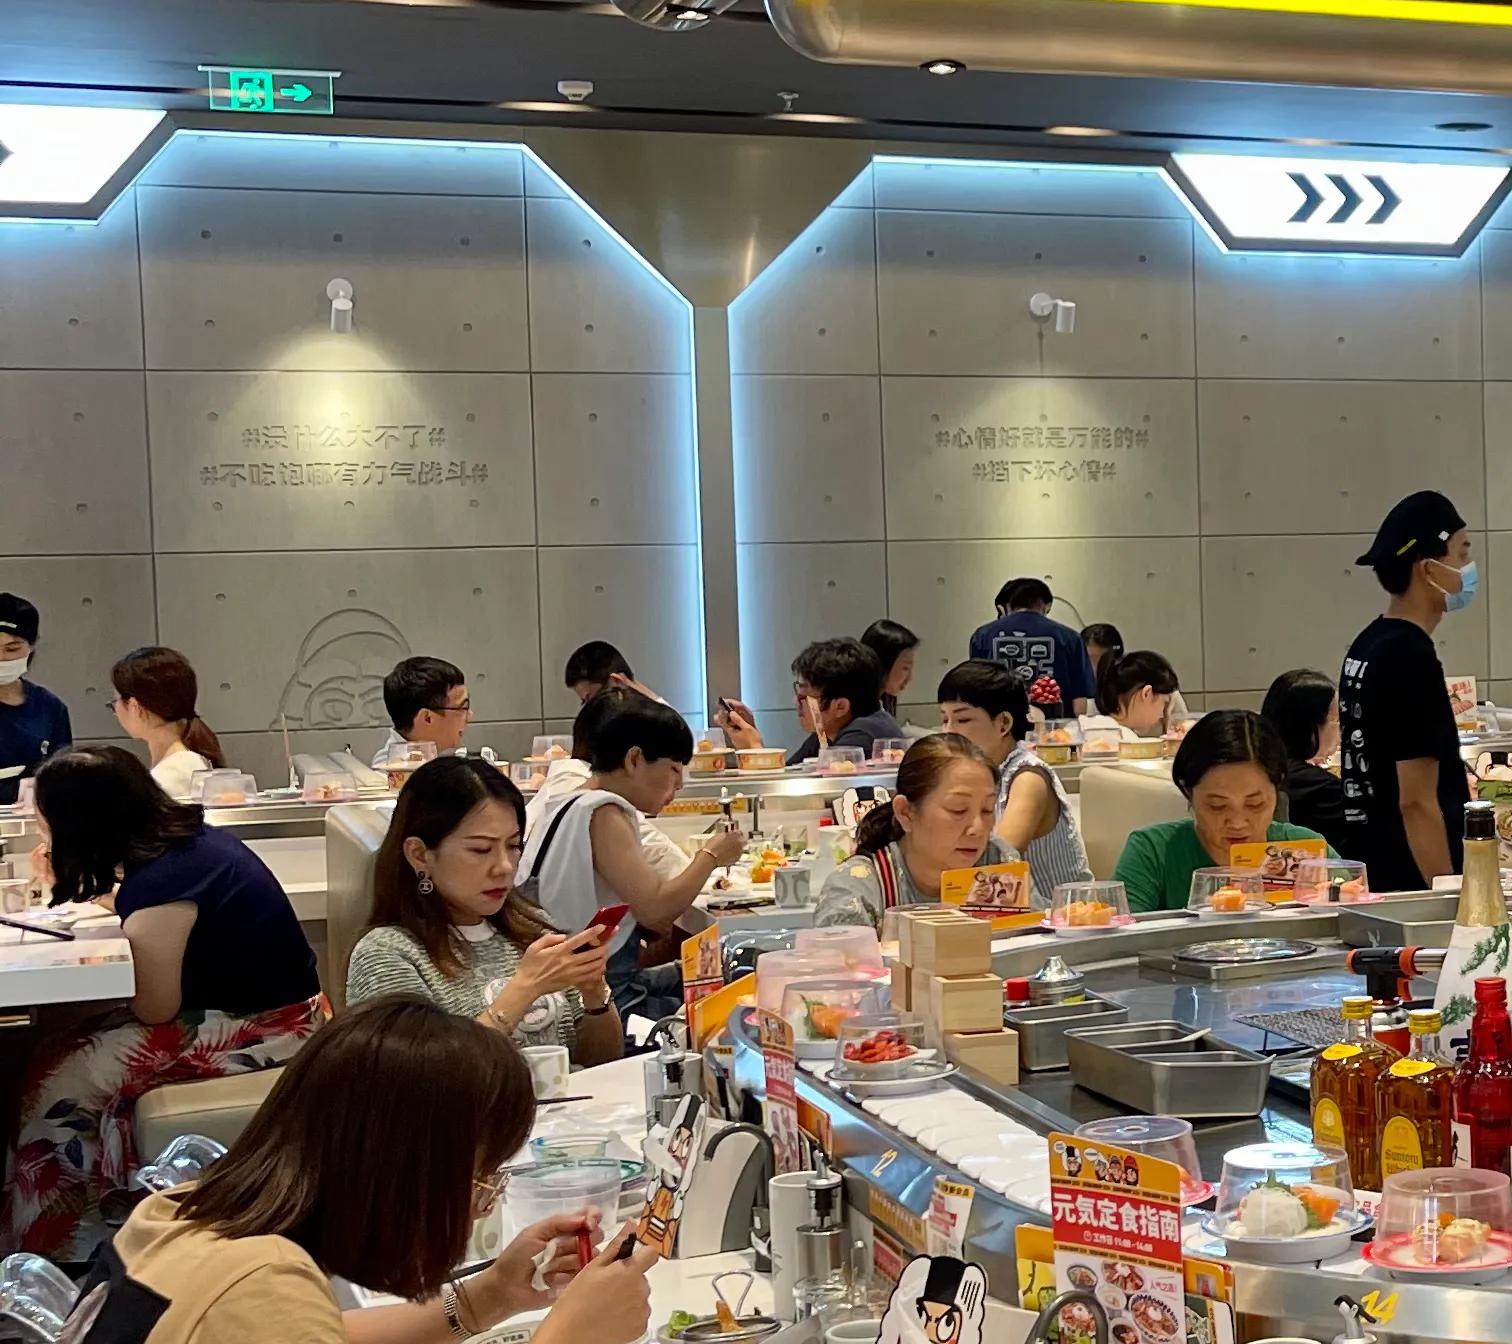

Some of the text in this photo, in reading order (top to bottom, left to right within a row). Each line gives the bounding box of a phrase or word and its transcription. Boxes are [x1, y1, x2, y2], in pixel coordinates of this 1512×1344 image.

[1053, 1192, 1181, 1243] 元気定食指南
